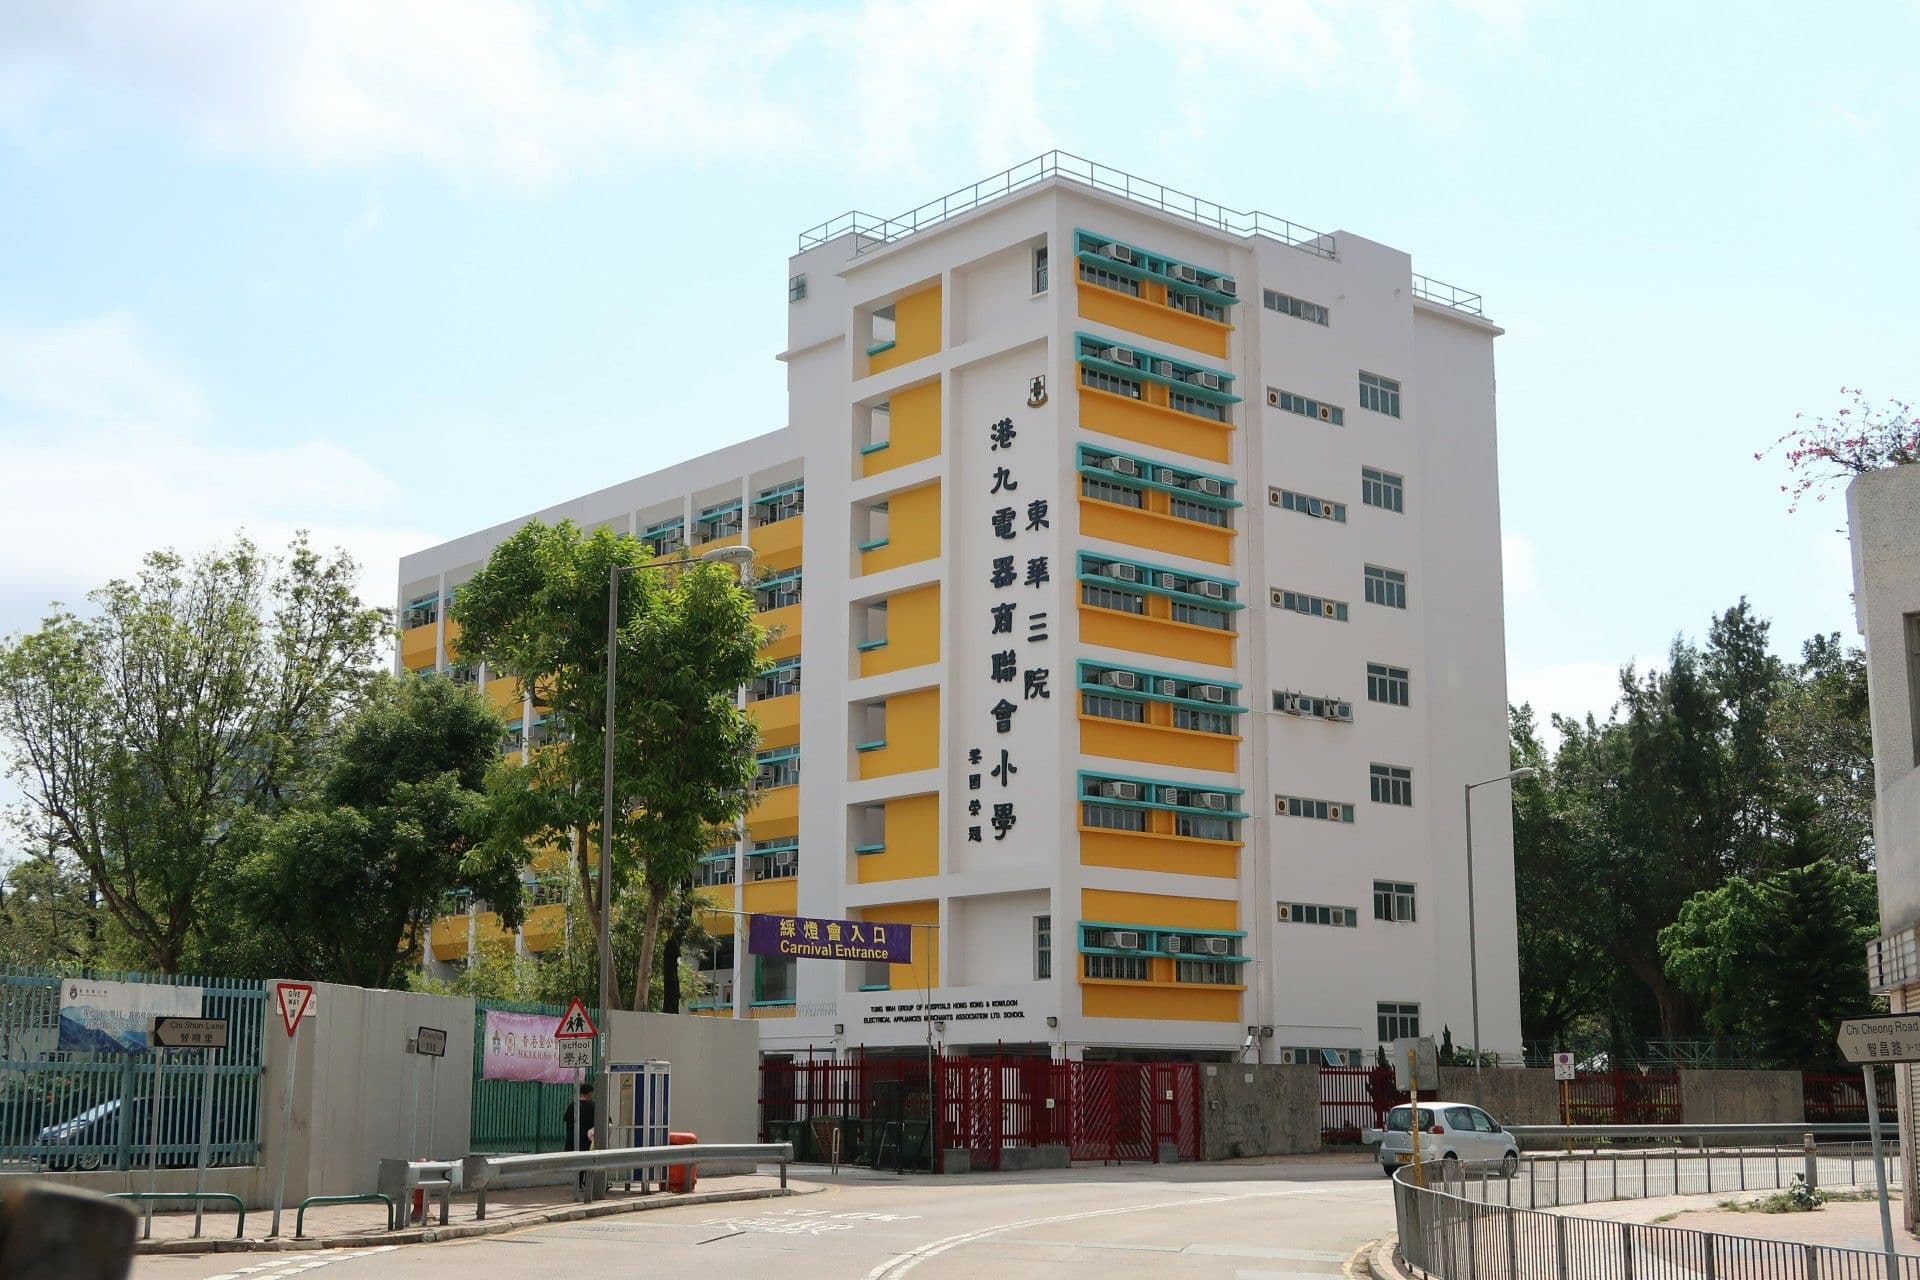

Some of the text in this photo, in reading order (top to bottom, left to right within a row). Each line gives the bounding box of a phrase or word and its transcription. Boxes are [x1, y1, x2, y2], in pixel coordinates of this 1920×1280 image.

[1024, 500, 1050, 700] 東華三院
[990, 417, 1018, 840] 港九電器商聯會小學
[780, 918, 886, 944] 綵燈會入口
[780, 939, 889, 959] Carnival Entrance
[288, 990, 300, 998] GIVE
[916, 1003, 923, 1011] OF
[986, 1000, 990, 1008] &
[992, 999, 1018, 1007] KOWLOON
[170, 1021, 182, 1029] Chi
[206, 1022, 225, 1030] Lane
[863, 1016, 891, 1024] ELECTRICAL
[893, 1015, 922, 1023] APPLIANCES
[955, 1012, 988, 1020] ASSOCIATION
[1846, 1020, 1919, 1035] Chi Cheong Road
[1867, 1041, 1902, 1057] 智昌路
[564, 1052, 589, 1066] 學校
